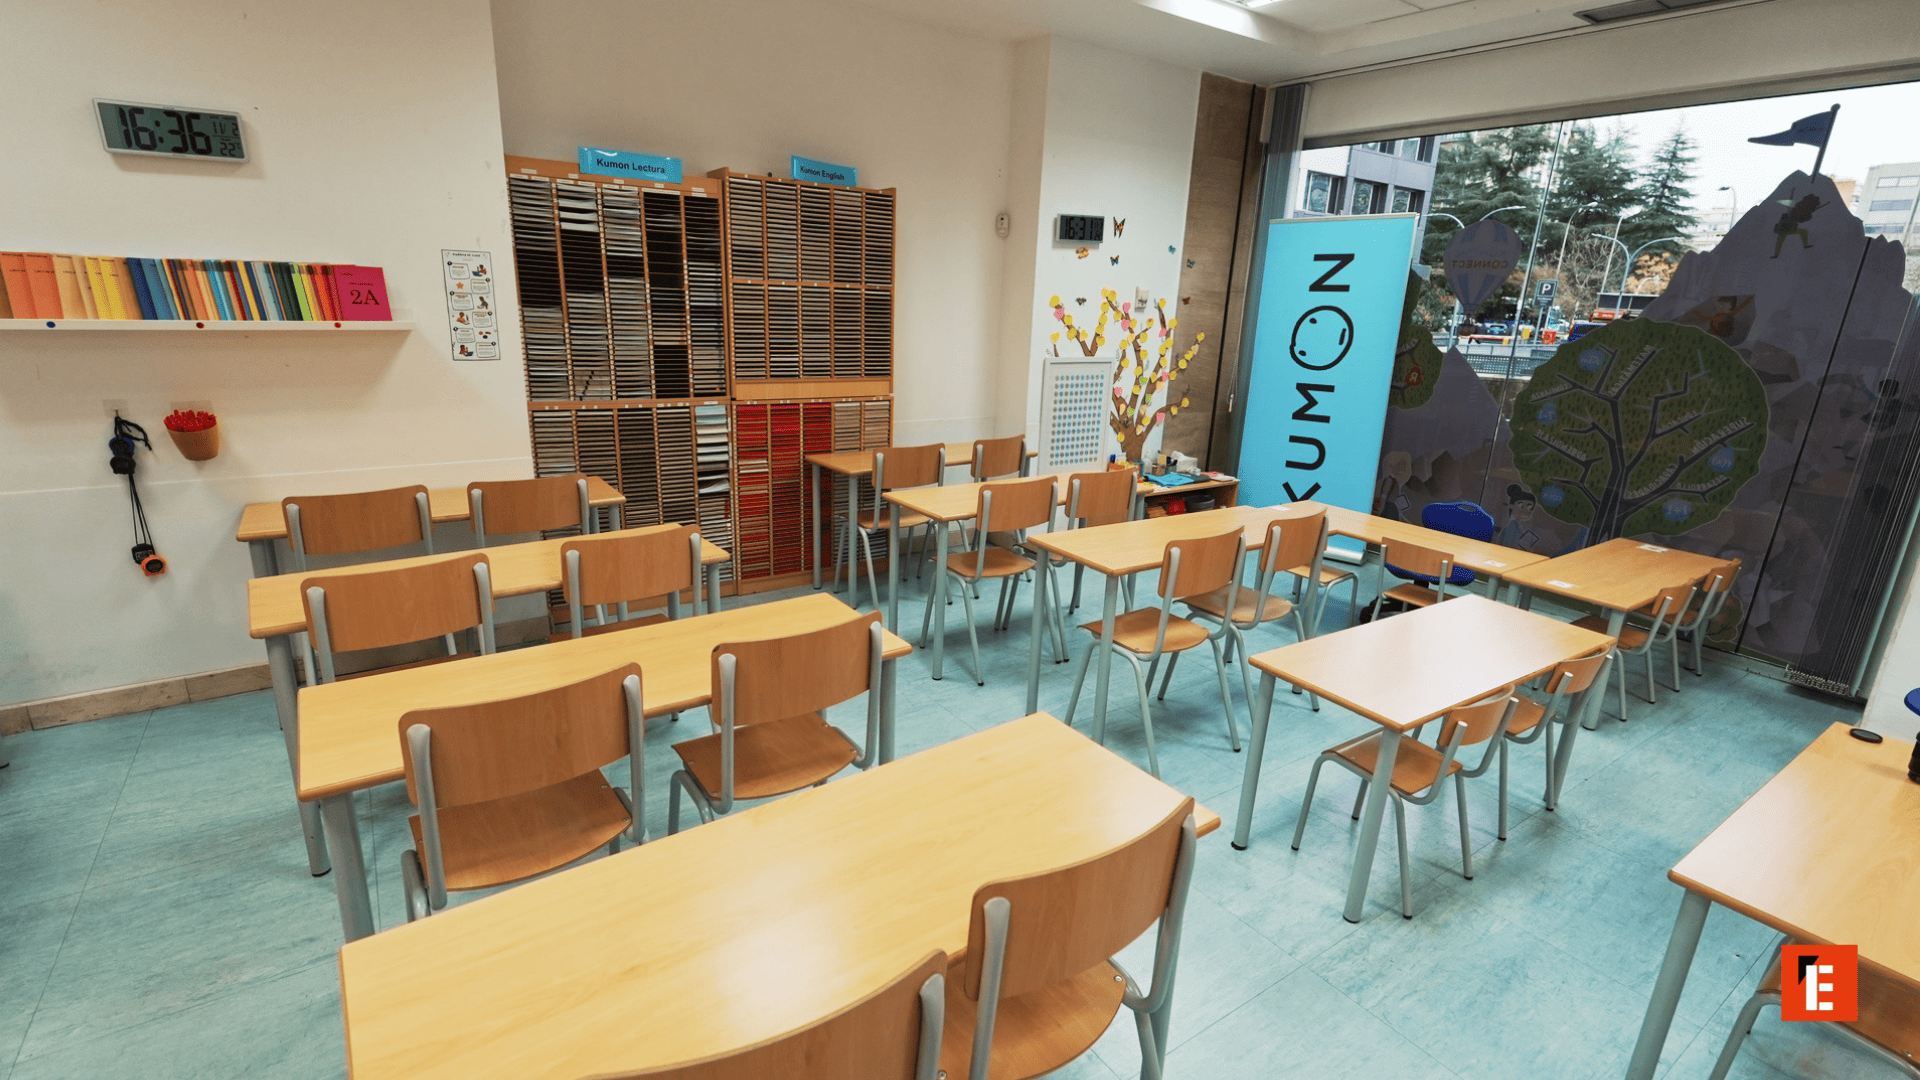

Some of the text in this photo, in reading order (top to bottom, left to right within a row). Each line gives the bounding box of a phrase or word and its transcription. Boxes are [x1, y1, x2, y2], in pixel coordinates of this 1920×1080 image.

[118, 106, 213, 155] 16:36
[596, 158, 666, 174] Kumon Lectura
[800, 165, 845, 181] Kumon English
[1541, 283, 1552, 295] P
[349, 289, 381, 306] 2A
[1282, 253, 1355, 503] KUMON
